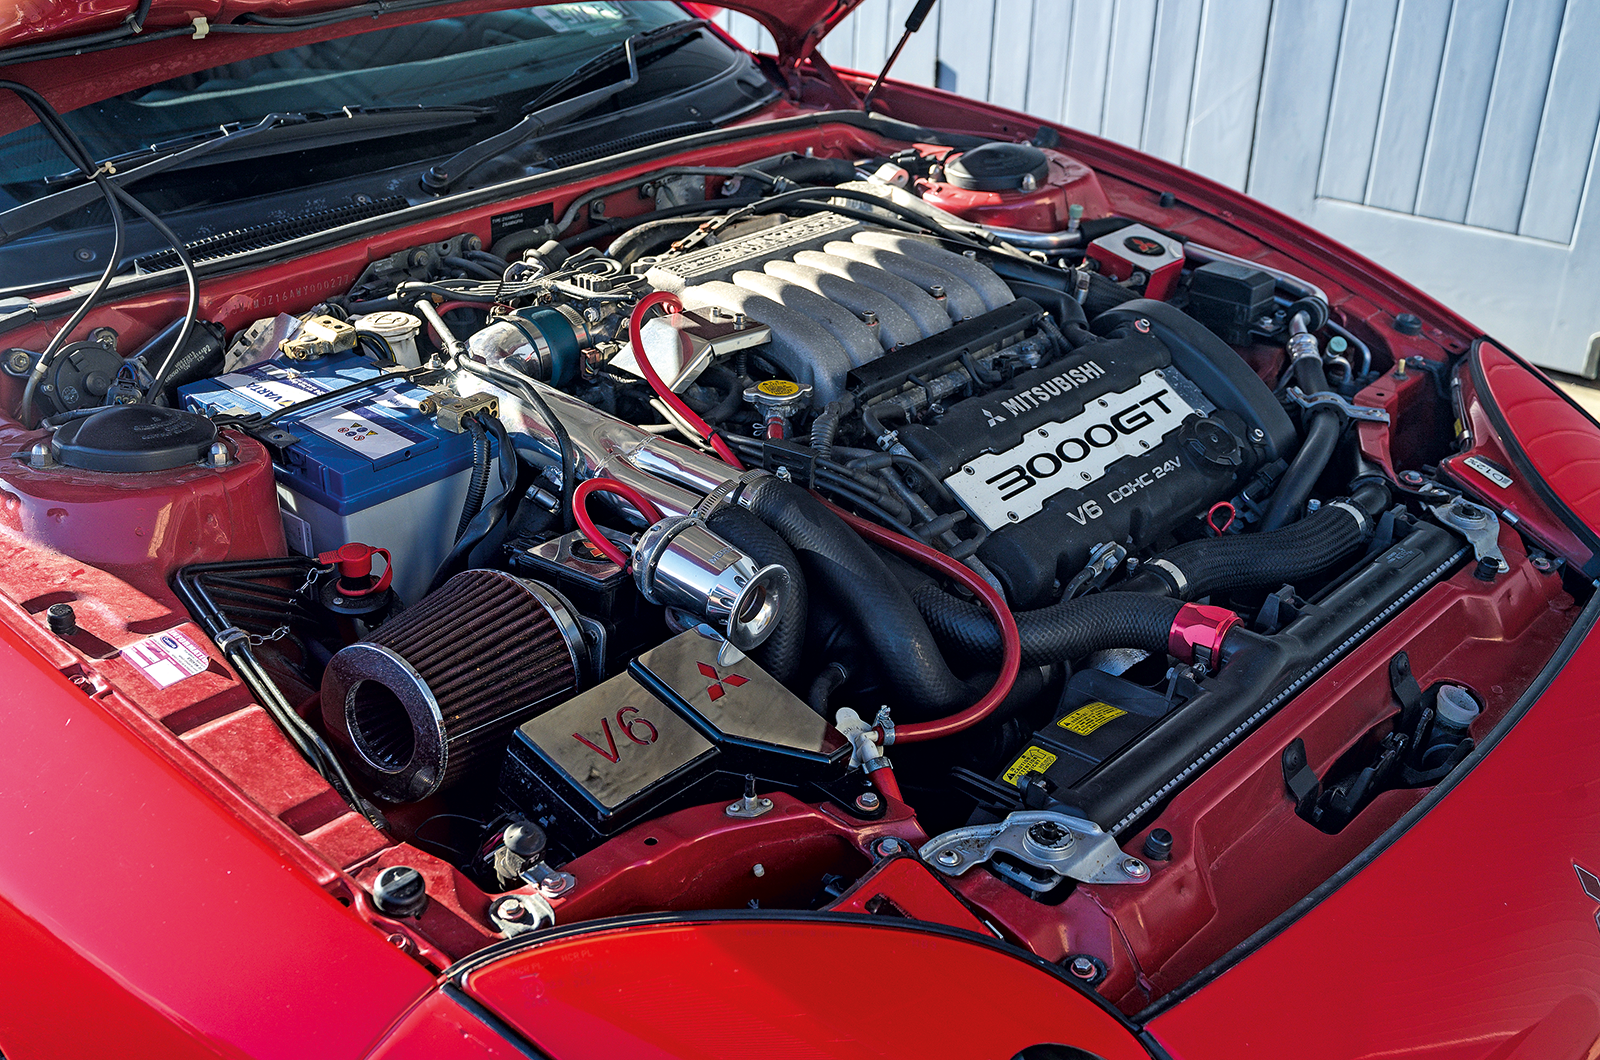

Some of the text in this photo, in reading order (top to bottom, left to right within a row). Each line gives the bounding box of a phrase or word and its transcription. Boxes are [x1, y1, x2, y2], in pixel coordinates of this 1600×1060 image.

[245, 382, 284, 403] VARTA
[1001, 360, 1106, 419] MITSUBISHI
[985, 388, 1172, 502] 3000GT
[1066, 455, 1183, 526] V6 DOHC 24V
[572, 707, 660, 764] V6
